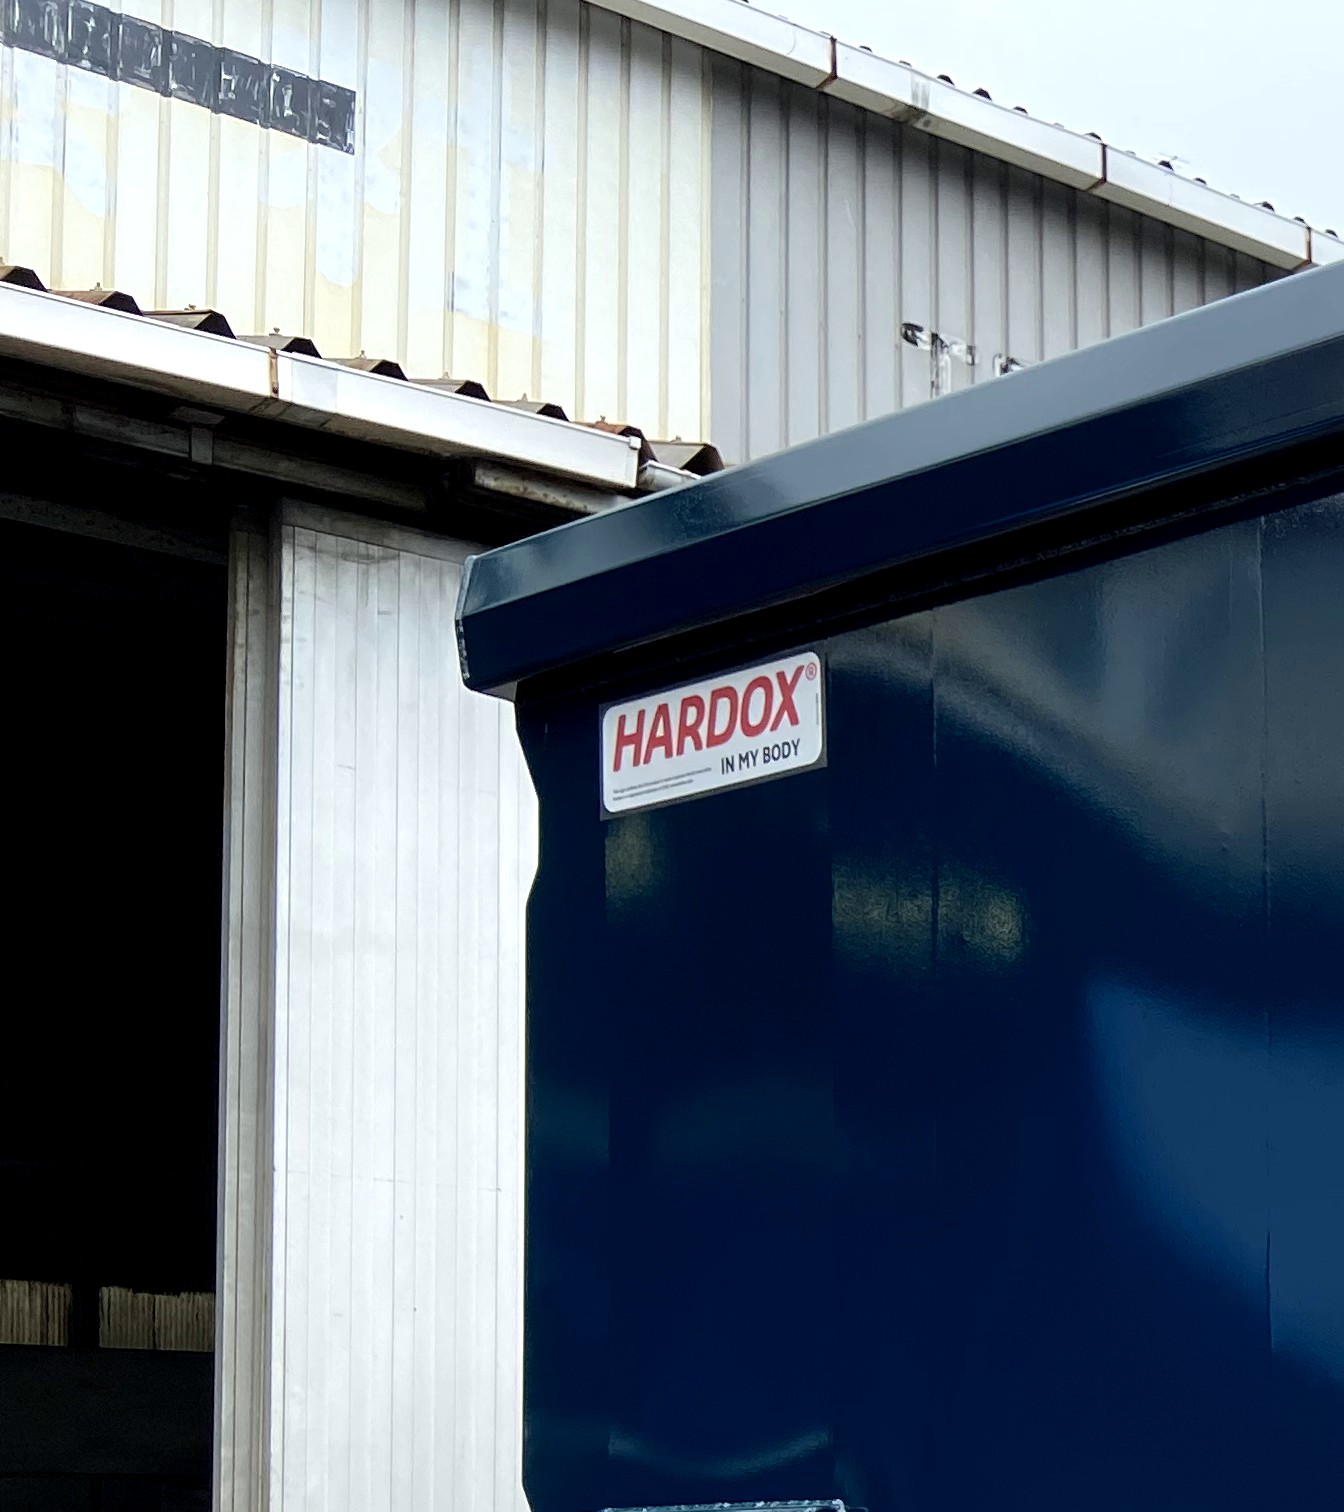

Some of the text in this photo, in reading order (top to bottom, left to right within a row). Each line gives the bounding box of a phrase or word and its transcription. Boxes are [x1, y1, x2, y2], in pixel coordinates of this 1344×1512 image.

[721, 738, 800, 775] IN MY BODY
